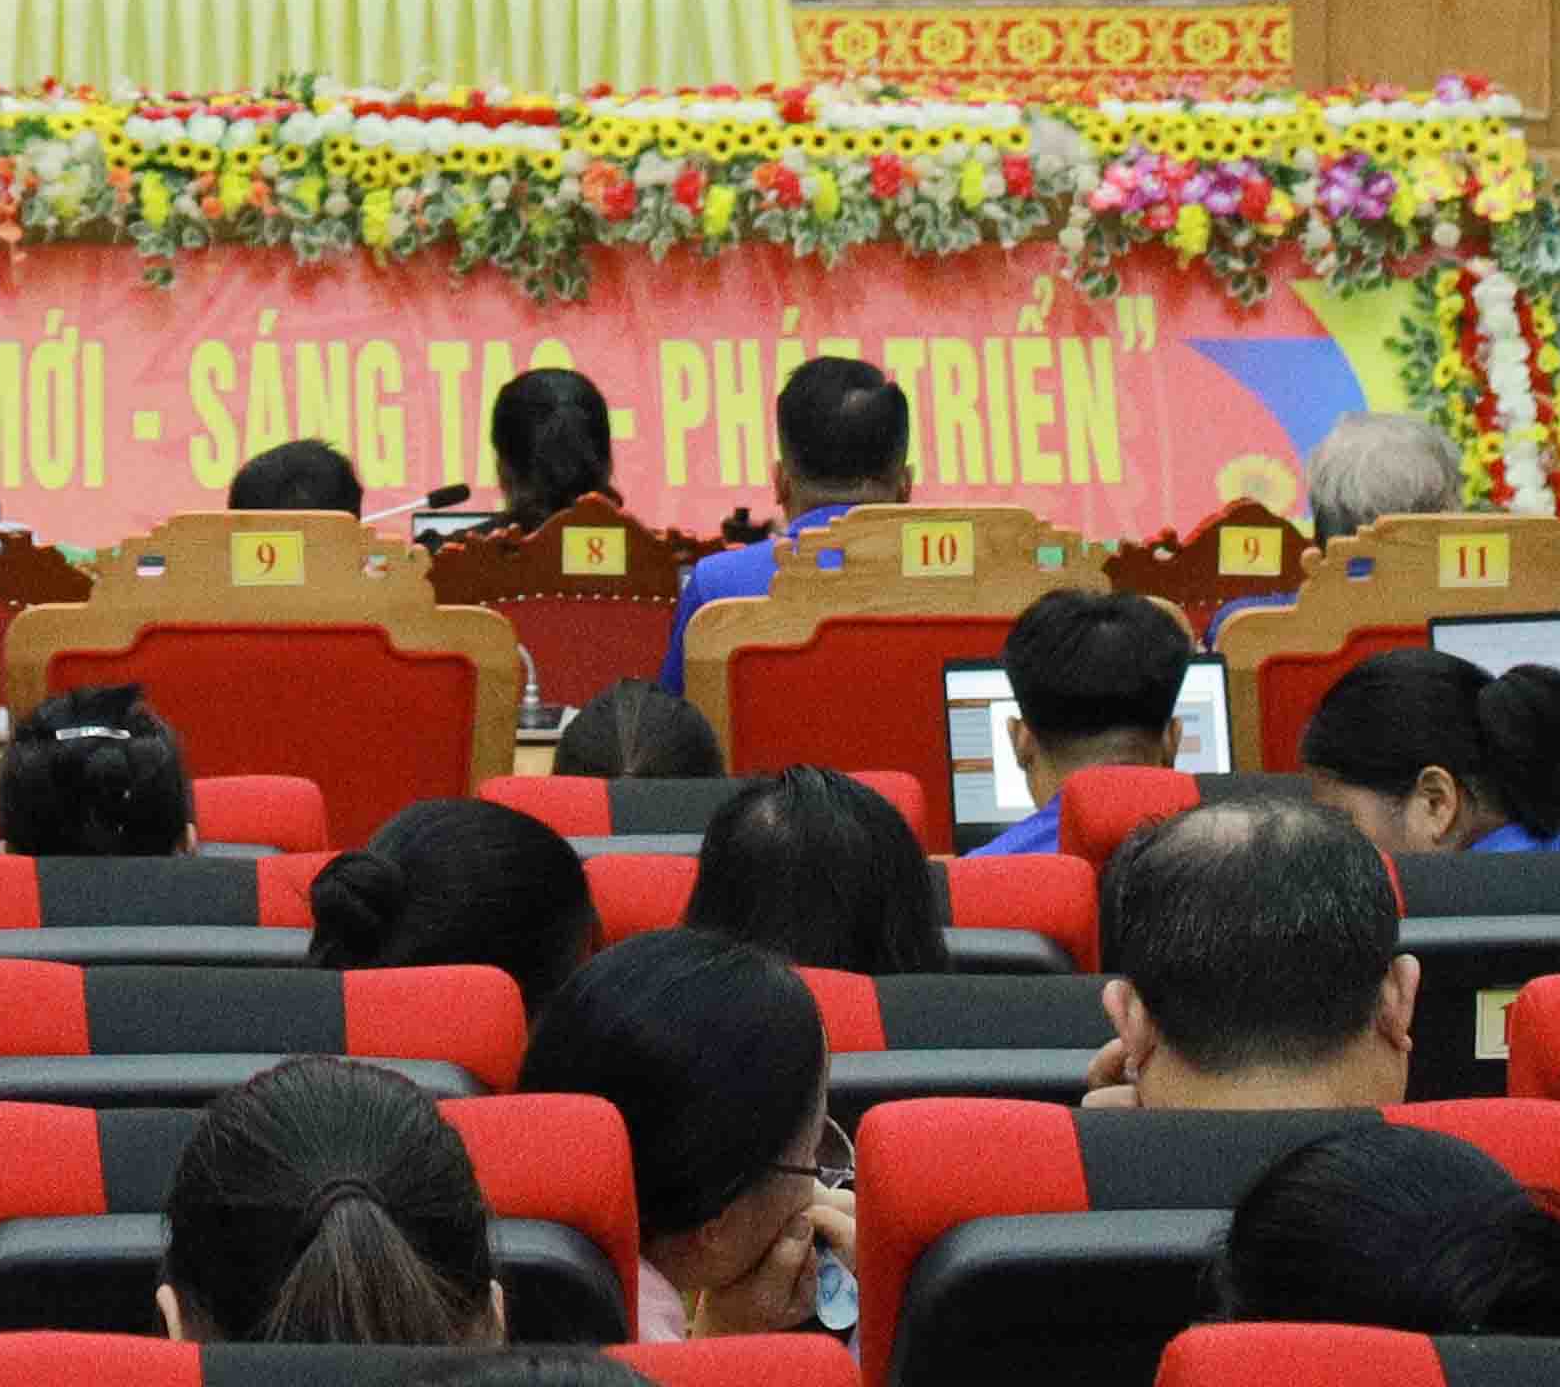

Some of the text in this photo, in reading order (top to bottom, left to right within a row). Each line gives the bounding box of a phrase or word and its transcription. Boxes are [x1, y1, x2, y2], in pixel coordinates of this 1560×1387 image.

[188, 309, 405, 489] SÁNG
[256, 544, 275, 576] 9
[586, 538, 605, 565] 8
[919, 534, 958, 567] 10
[1243, 538, 1260, 565] 9
[1456, 546, 1488, 576] 11
